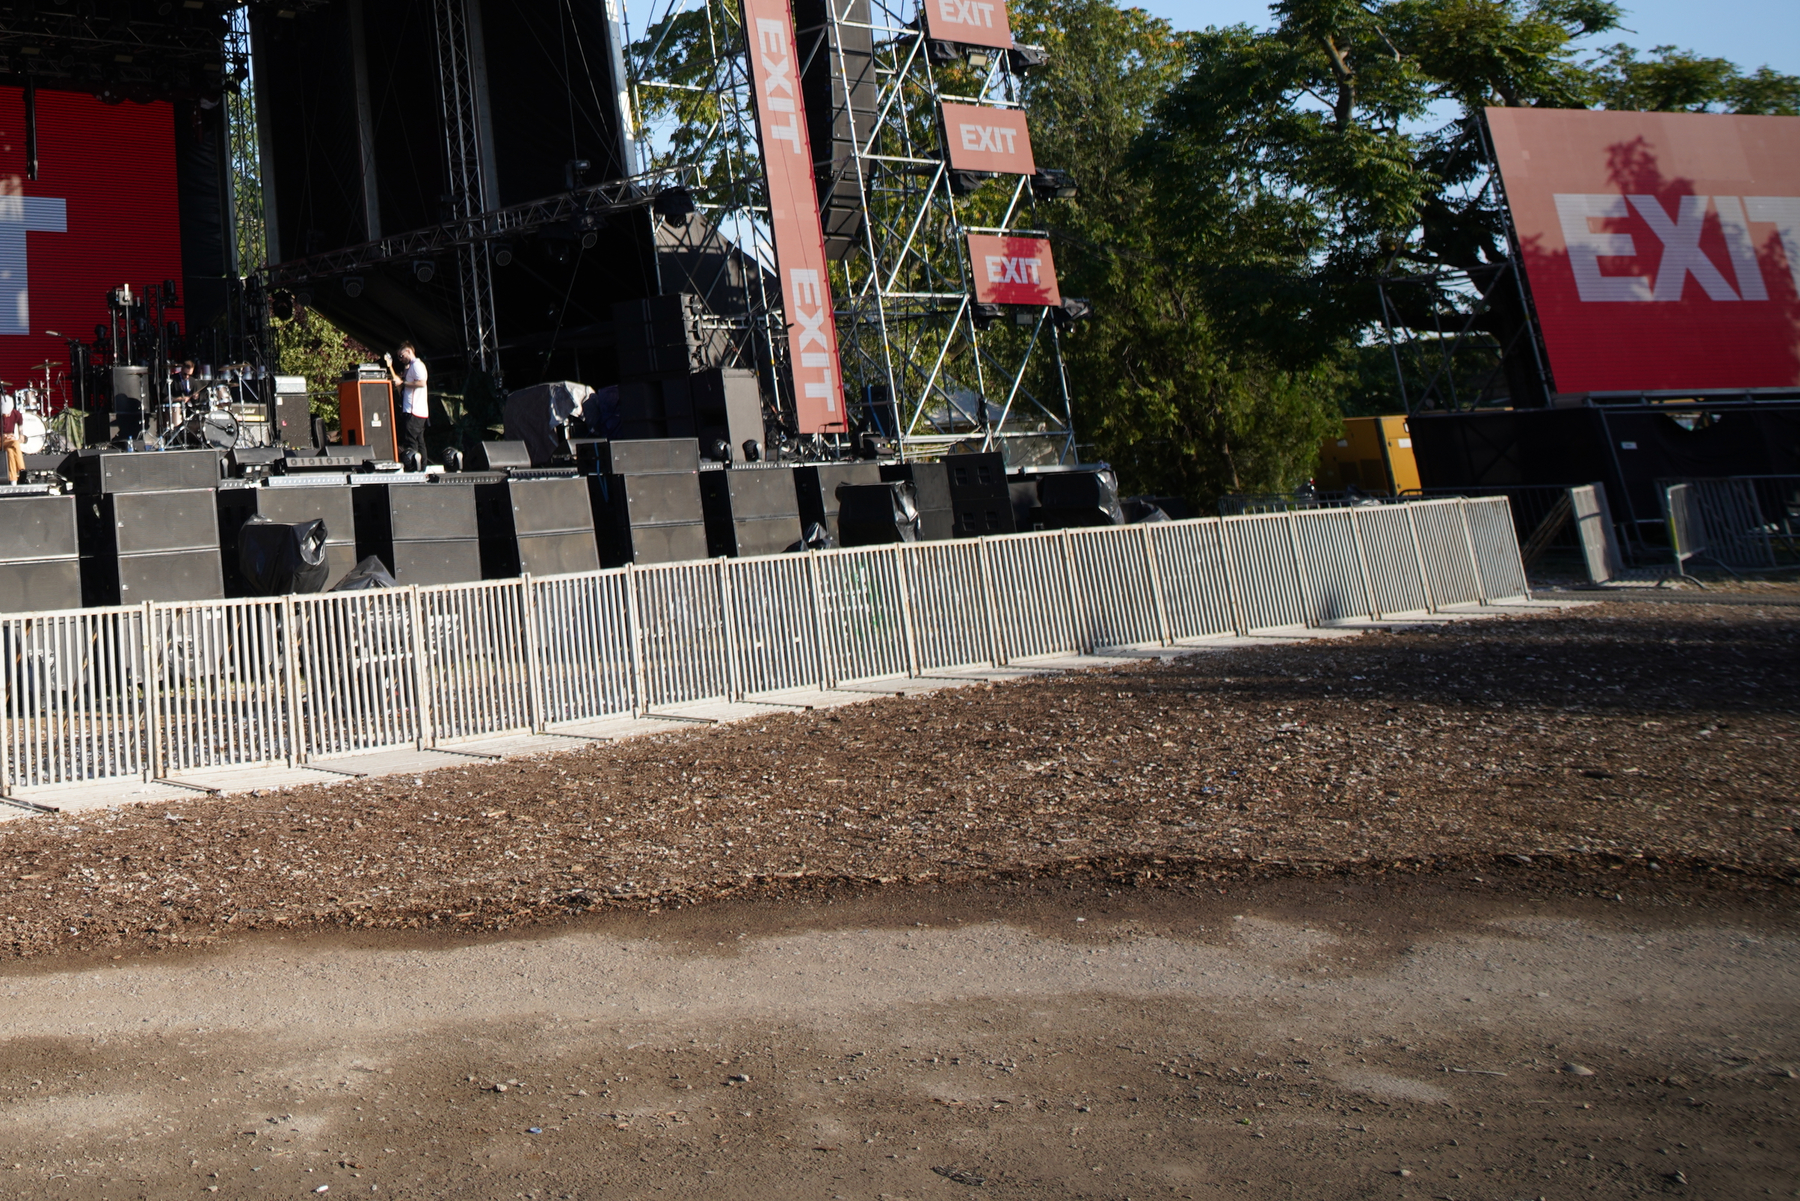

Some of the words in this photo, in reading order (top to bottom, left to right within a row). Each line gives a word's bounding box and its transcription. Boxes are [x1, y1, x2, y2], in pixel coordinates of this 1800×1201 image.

[755, 18, 801, 155] EXIT
[959, 123, 1017, 154] EXIT
[984, 254, 1042, 285] EXIT
[789, 268, 835, 412] EXIT
